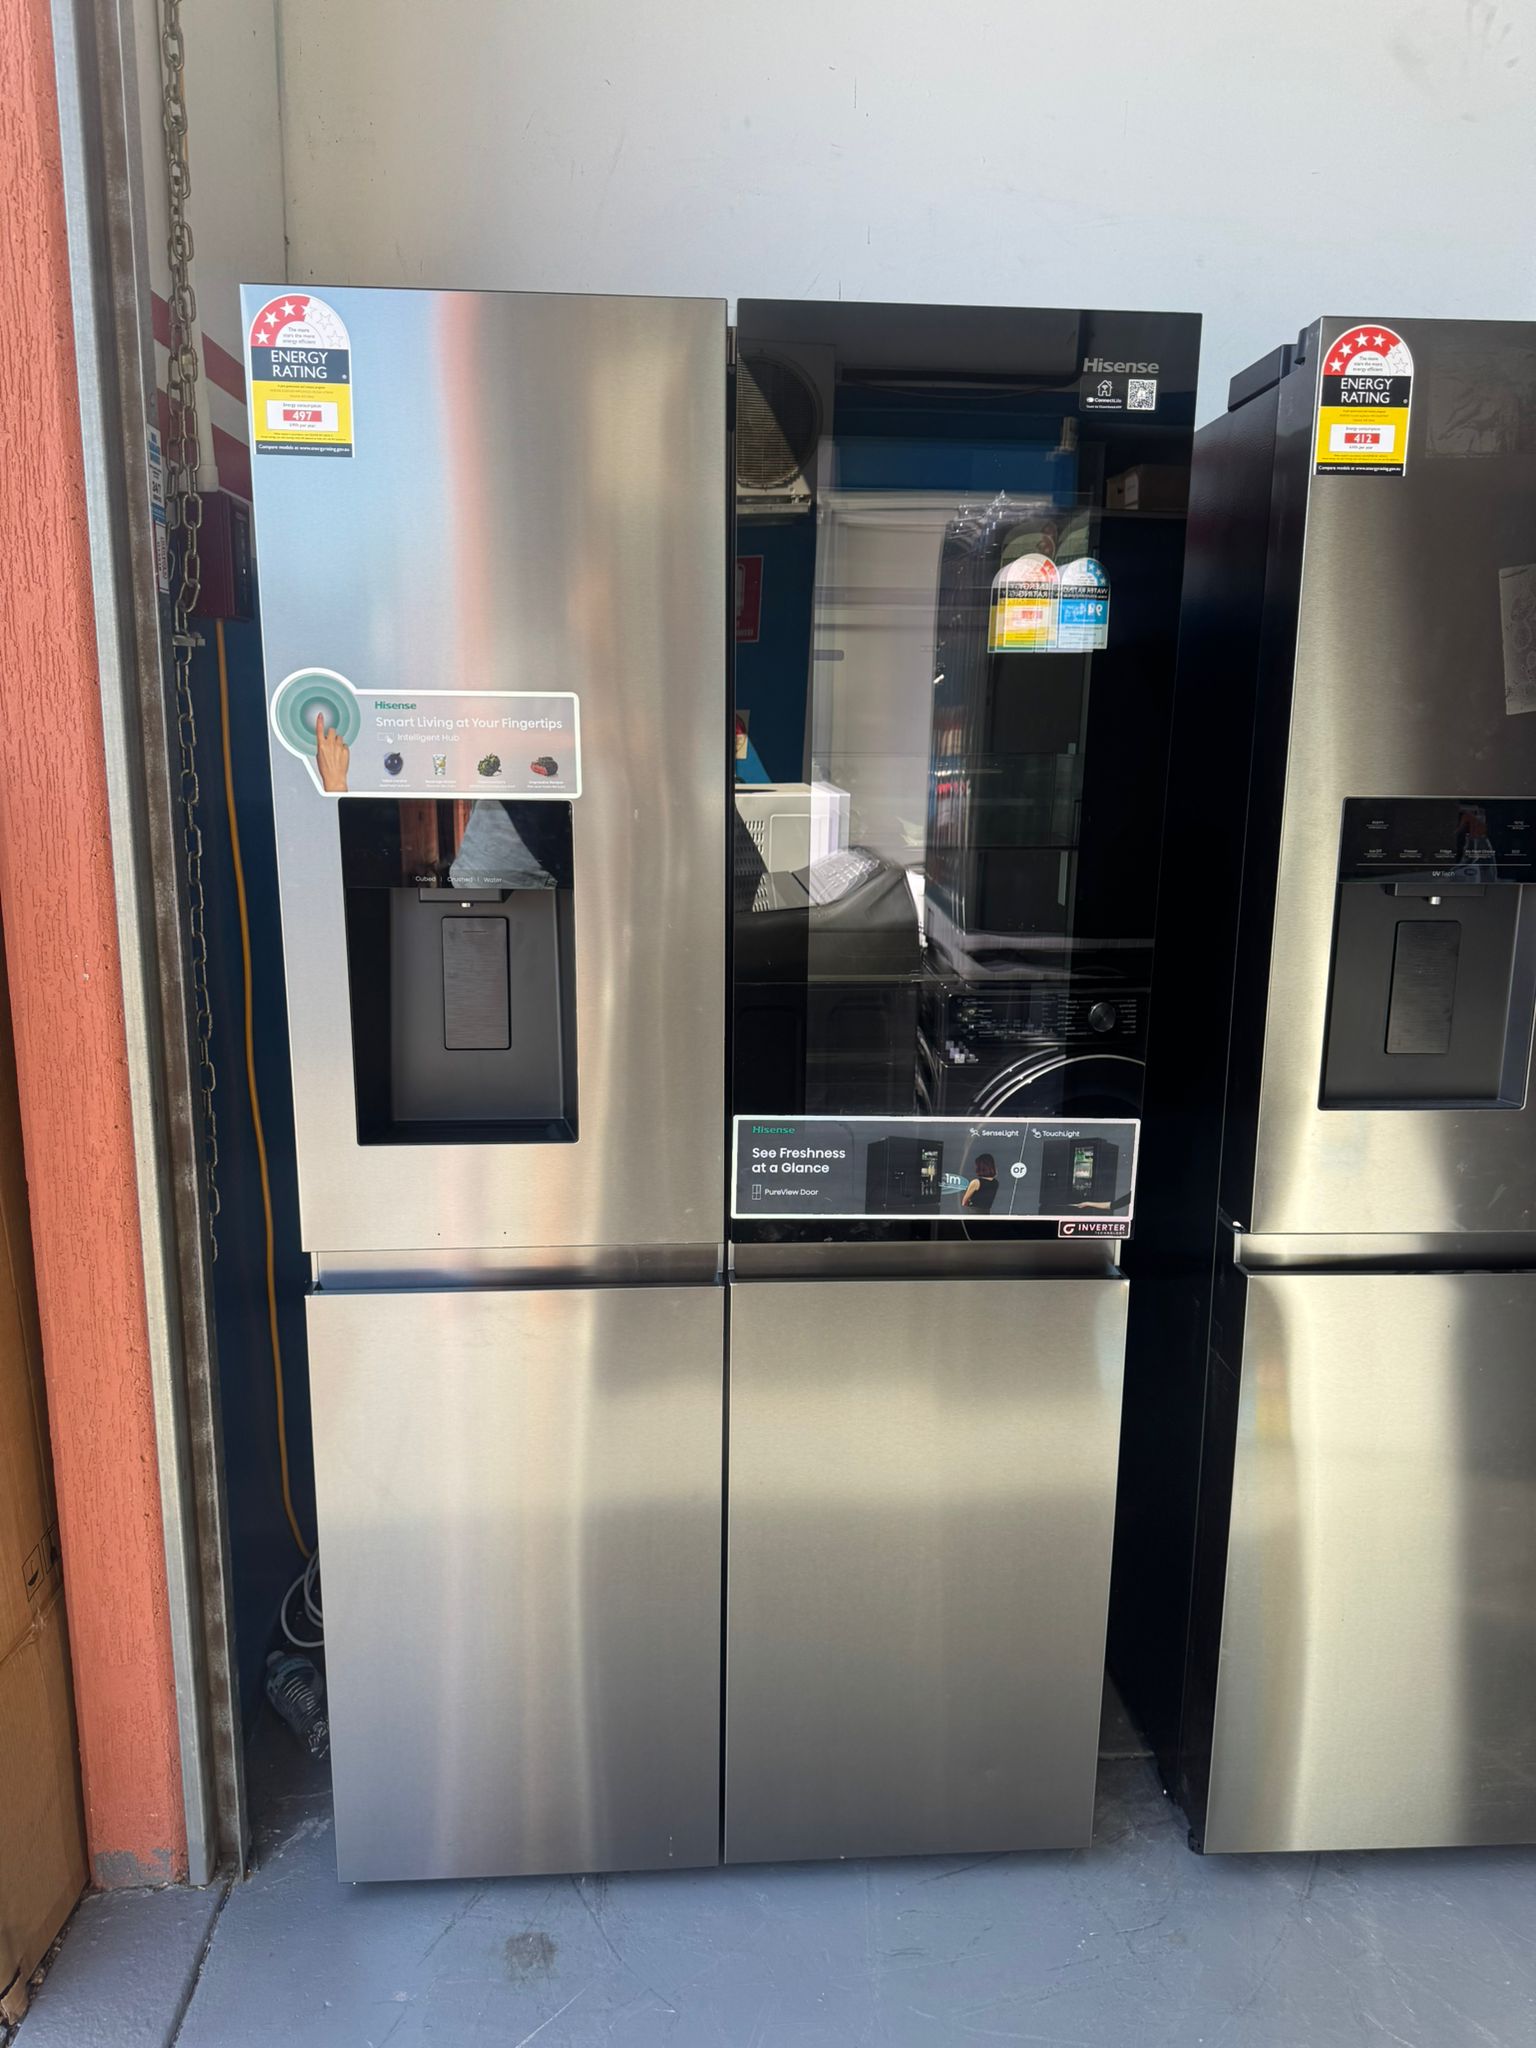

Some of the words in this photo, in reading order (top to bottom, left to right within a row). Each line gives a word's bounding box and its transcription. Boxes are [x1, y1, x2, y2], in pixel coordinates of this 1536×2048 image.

[271, 350, 328, 365] ENERGY
[272, 365, 328, 379] RATING
[1083, 358, 1160, 374] Hisense
[1340, 378, 1393, 390] ENERGY
[1341, 392, 1390, 404] RATING
[292, 411, 312, 421] 497
[1354, 434, 1372, 443] 412
[375, 701, 417, 710] Hisense
[376, 717, 414, 728] Smart
[417, 717, 454, 730] Living
[456, 718, 470, 728] at
[472, 718, 498, 729] Your
[502, 718, 562, 731] Fingertips
[397, 733, 440, 743] Intelligent
[442, 734, 460, 742] Hub
[752, 1126, 795, 1134] Hisense
[981, 1130, 1019, 1138] SenseLight
[1042, 1130, 1080, 1138] TouchLight
[752, 1147, 776, 1159] See
[780, 1147, 846, 1159] Freshness
[752, 1163, 767, 1174] at
[769, 1164, 778, 1173] a
[782, 1162, 830, 1174] Glance
[1013, 1166, 1024, 1174] or
[945, 1173, 961, 1185] 1m
